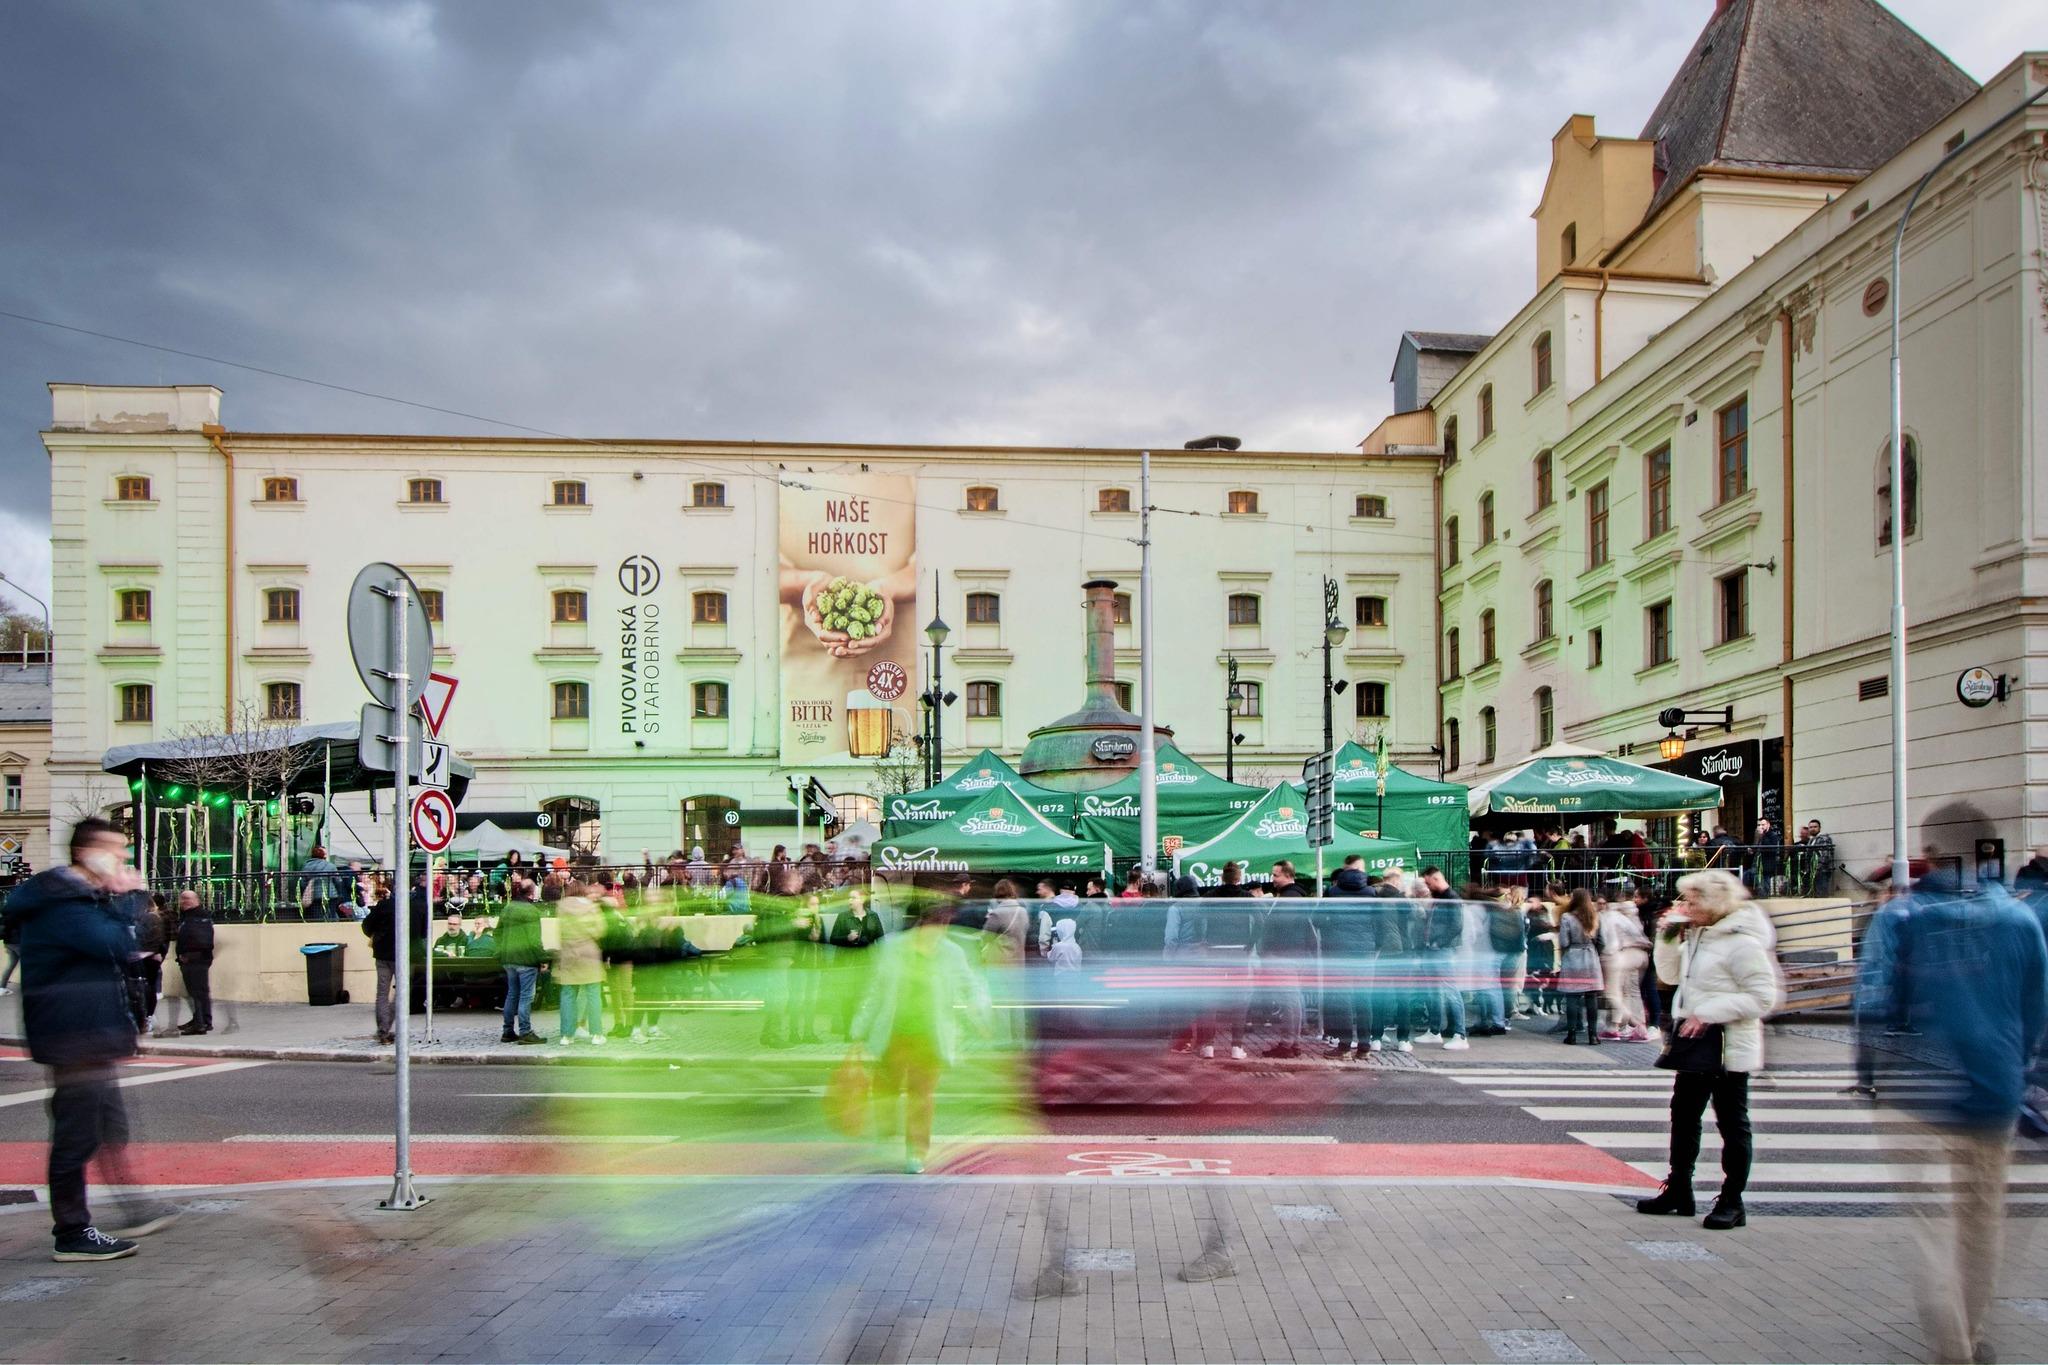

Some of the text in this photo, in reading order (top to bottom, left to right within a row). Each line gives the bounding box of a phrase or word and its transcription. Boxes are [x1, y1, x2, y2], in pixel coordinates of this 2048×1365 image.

[826, 496, 870, 523] NAŠE
[808, 527, 888, 555] HOŘKOST
[617, 605, 637, 733] PIVOVARSKÁ
[643, 604, 660, 734] STAROBRNO
[791, 705, 833, 722] BITR
[1095, 741, 1133, 752] Starobrno
[1701, 749, 1743, 780] Starobrno
[1155, 771, 1198, 785] tarobrno
[1547, 770, 1634, 786] Starobrno
[1037, 804, 1064, 813] 1872
[1080, 795, 1141, 817] Starobr
[1229, 800, 1256, 809] 1872
[1427, 796, 1455, 805] 1872
[1559, 797, 1582, 805] 1872
[960, 817, 1027, 835] Starobrno
[1055, 855, 1088, 865] 1872
[1371, 857, 1405, 869] 1872
